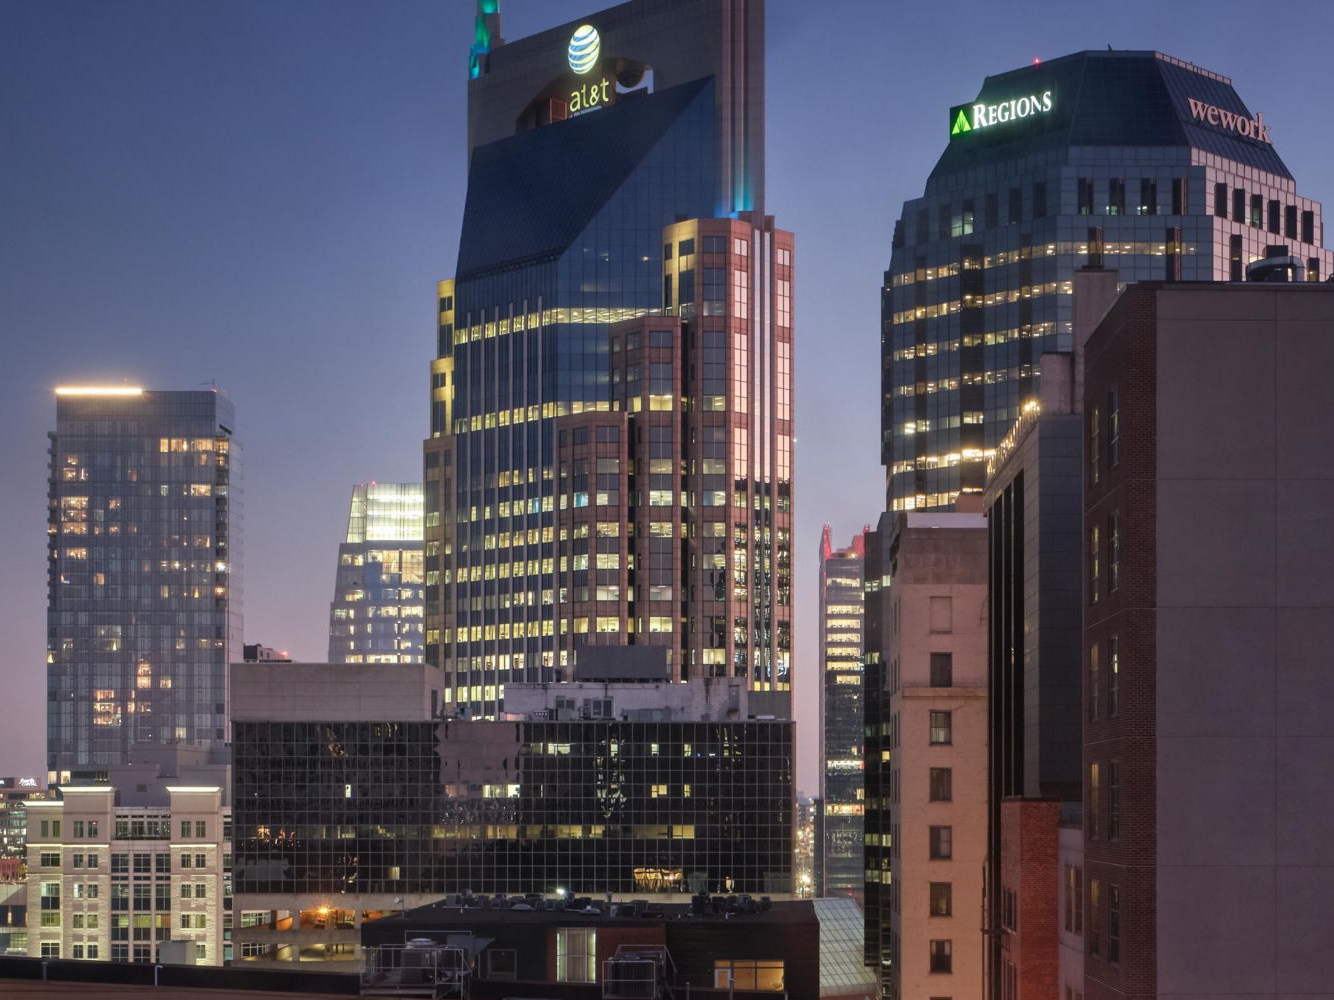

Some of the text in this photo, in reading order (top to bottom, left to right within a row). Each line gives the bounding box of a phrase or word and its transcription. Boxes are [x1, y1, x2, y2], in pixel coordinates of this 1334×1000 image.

[569, 77, 610, 112] at&t
[972, 90, 1052, 130] REGIONS
[1187, 97, 1273, 145] wework
